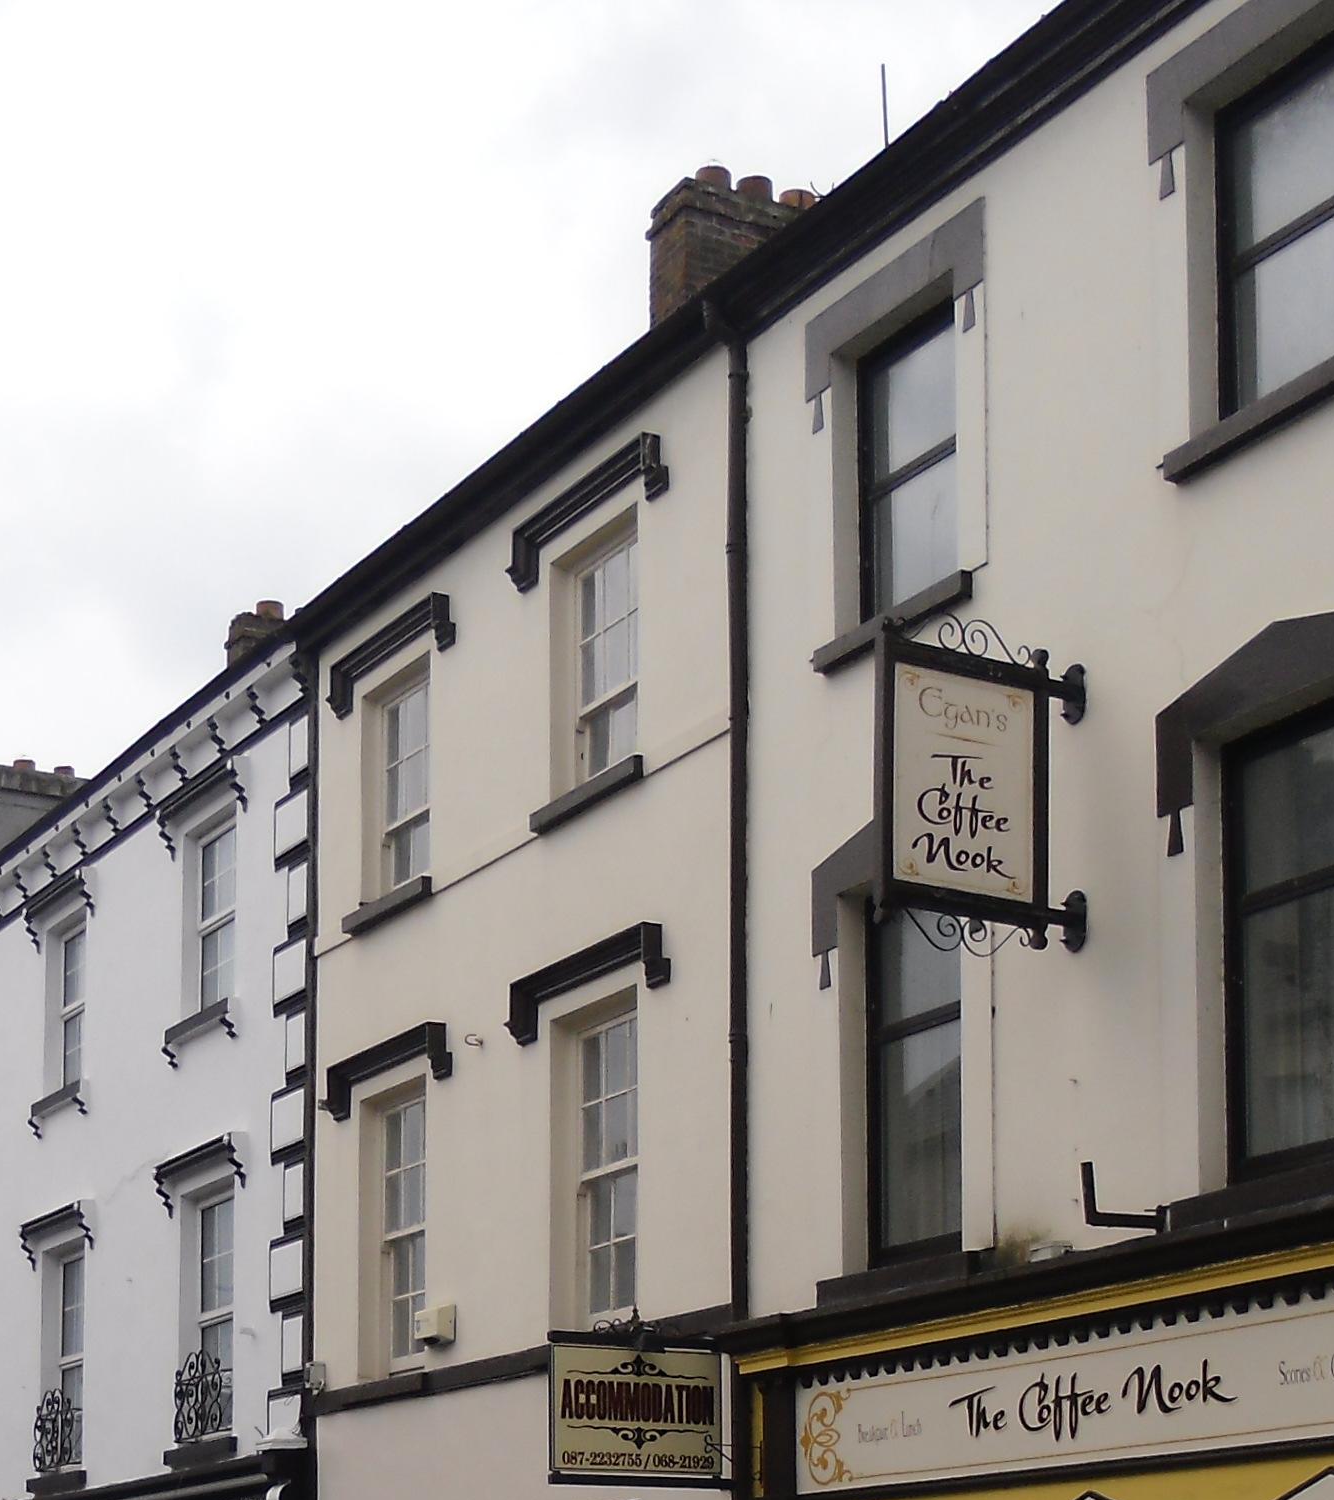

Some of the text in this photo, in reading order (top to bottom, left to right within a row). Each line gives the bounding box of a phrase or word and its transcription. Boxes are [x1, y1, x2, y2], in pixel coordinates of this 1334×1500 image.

[918, 685, 1009, 733] Egan's
[930, 753, 995, 790] The
[916, 782, 1011, 839] Coffee
[911, 832, 1017, 879] Nook
[560, 1378, 715, 1426] ACCOMMODATION
[948, 1358, 1238, 1442] The Coffee Nook
[561, 1450, 643, 1468] 087-2232755
[652, 1452, 715, 1470] 068-21929
